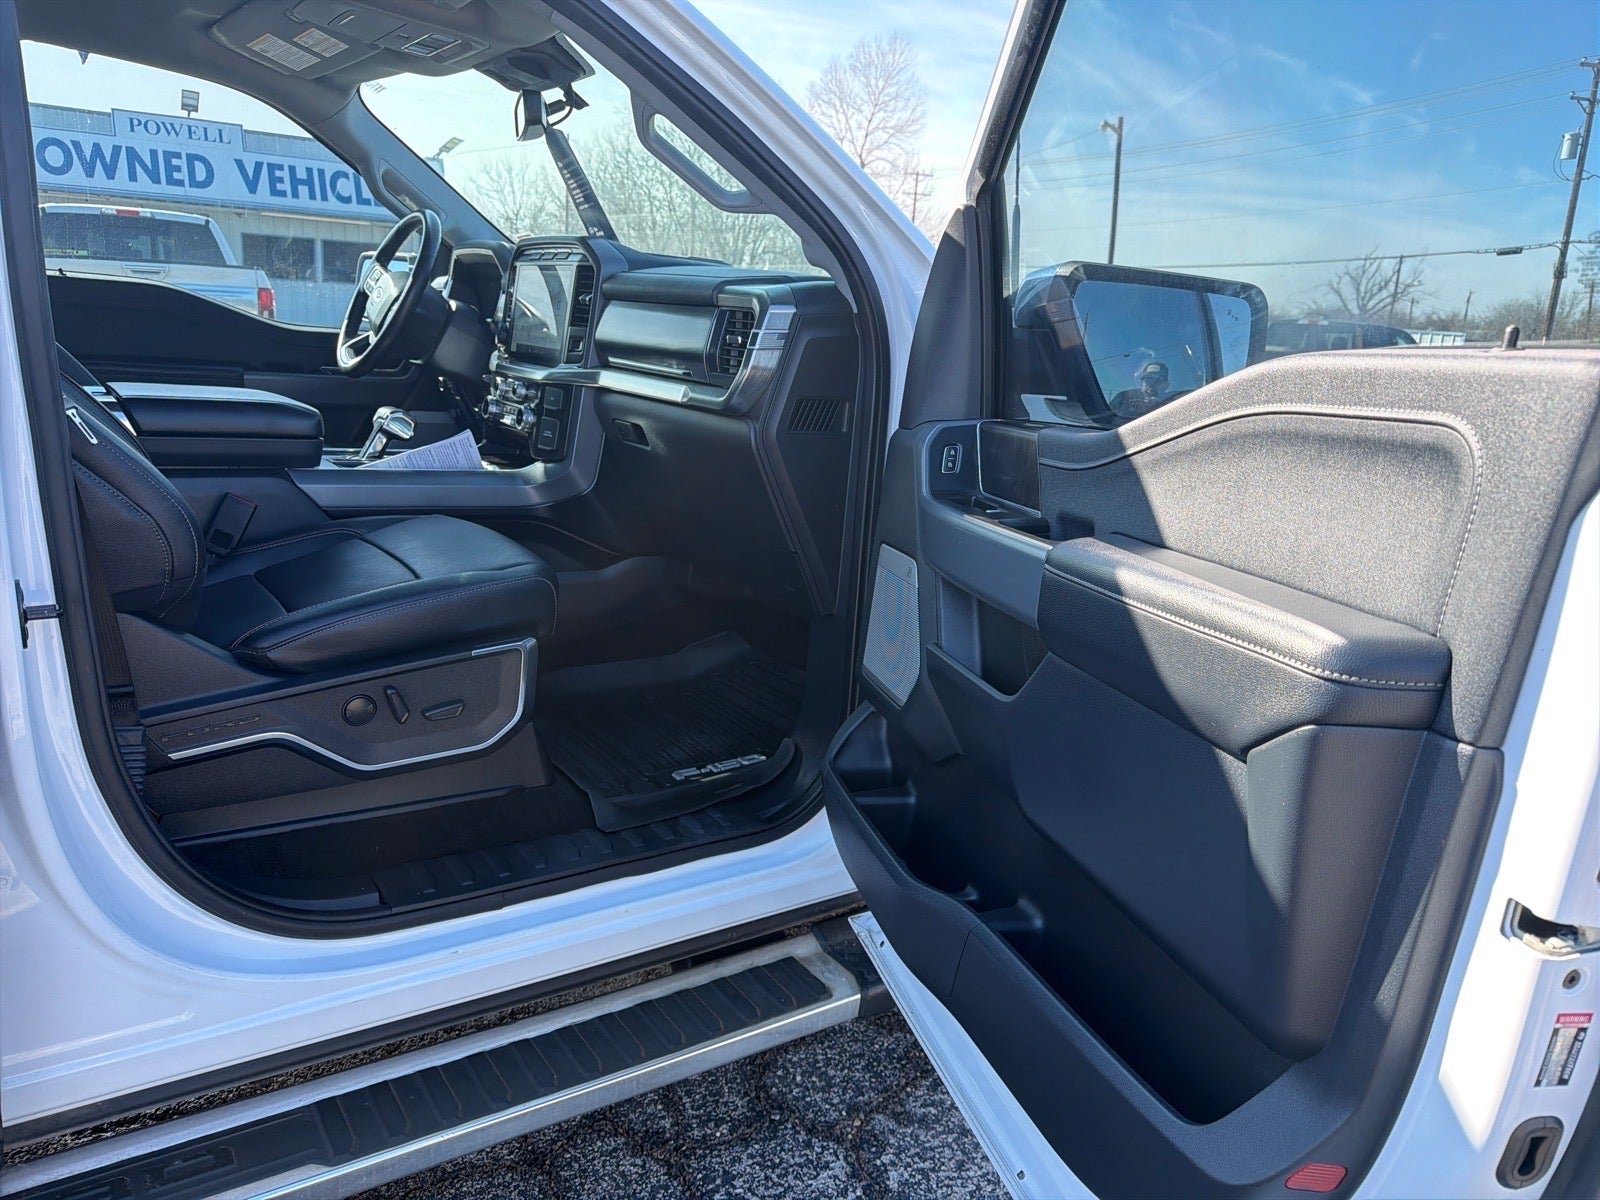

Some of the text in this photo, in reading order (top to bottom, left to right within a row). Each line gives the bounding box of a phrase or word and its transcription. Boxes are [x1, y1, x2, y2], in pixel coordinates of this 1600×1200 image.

[128, 116, 232, 145] POWELL
[35, 136, 383, 208] OWNED VEHICL
